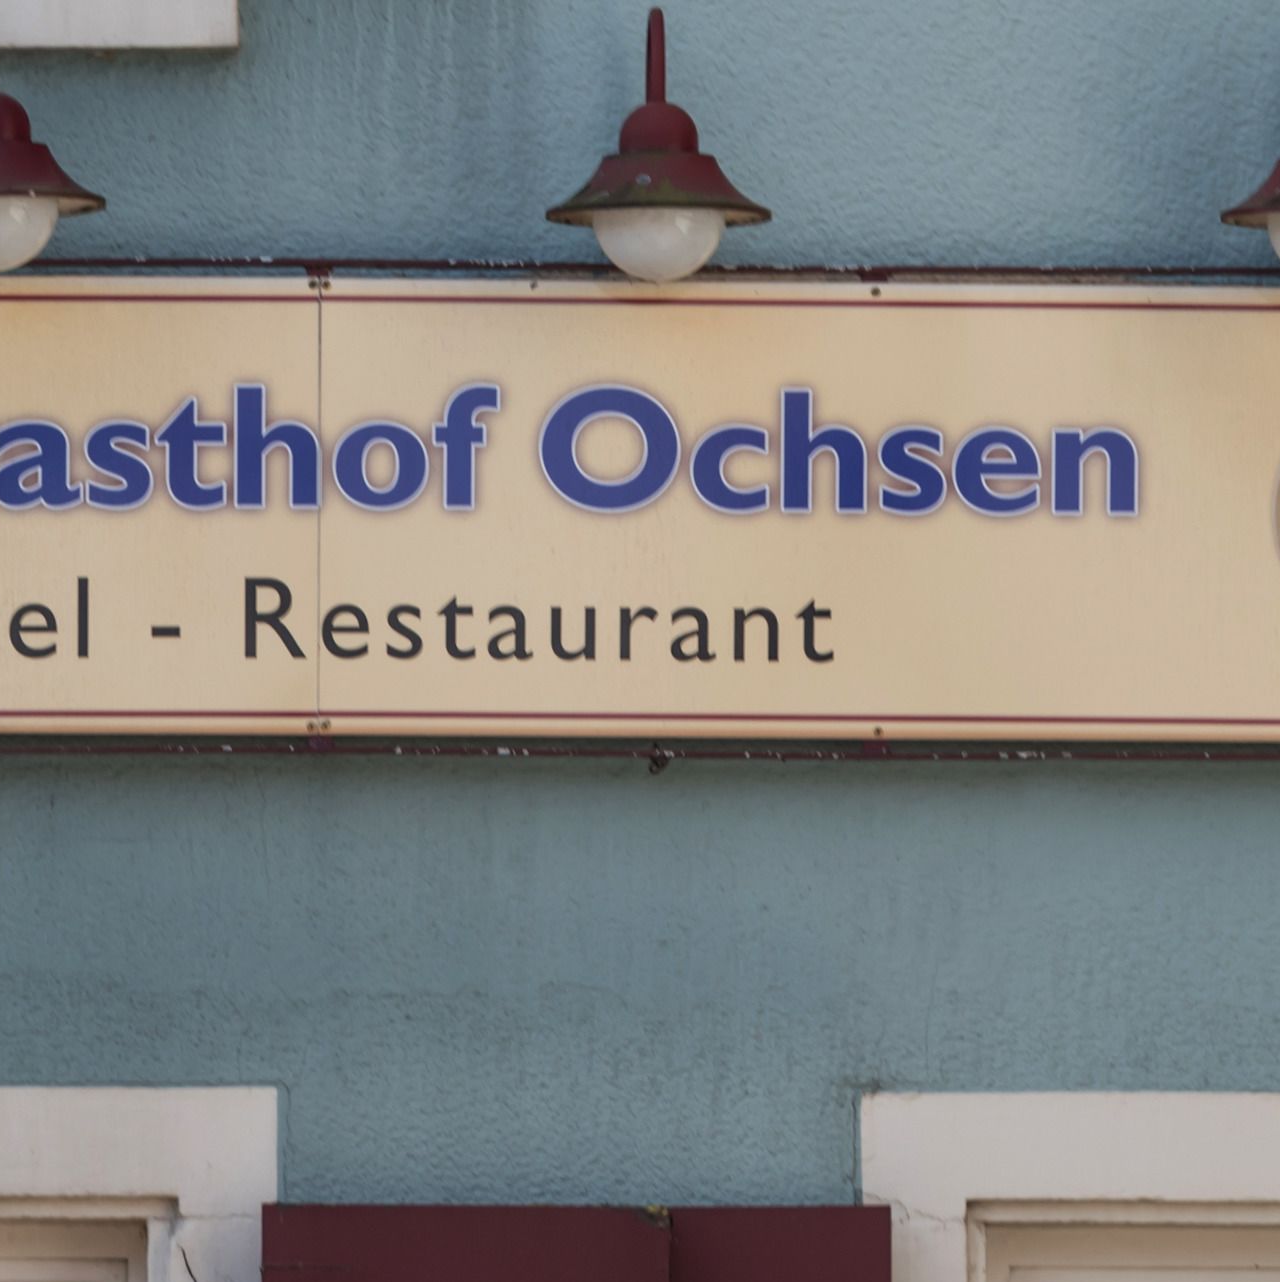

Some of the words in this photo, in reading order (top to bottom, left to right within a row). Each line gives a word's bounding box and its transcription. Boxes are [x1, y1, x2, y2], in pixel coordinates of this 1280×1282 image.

[538, 384, 1140, 516] Ochsen
[150, 624, 181, 639] -
[242, 576, 835, 663] Restaurant
